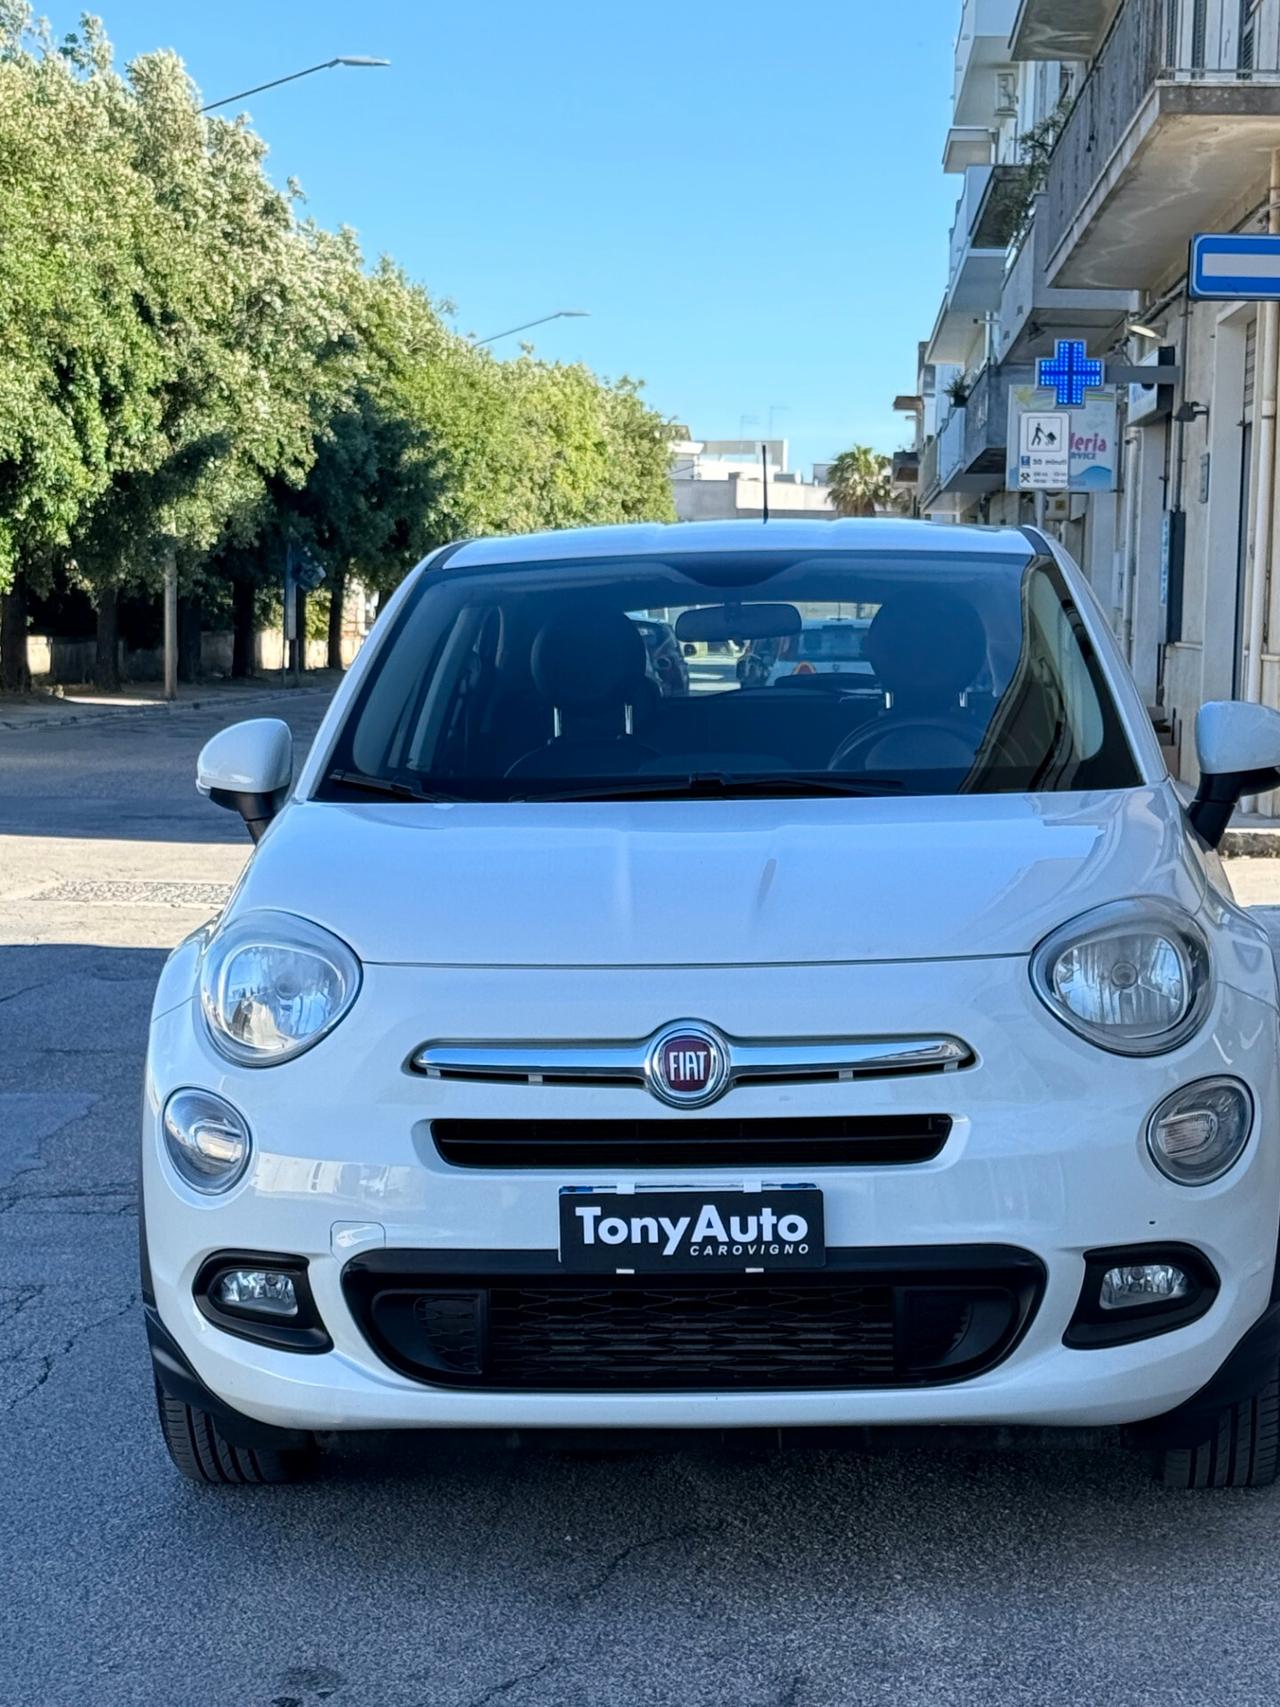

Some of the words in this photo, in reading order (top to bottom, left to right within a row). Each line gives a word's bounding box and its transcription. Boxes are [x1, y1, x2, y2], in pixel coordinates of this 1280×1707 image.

[669, 1051, 707, 1081] FIAT
[575, 1204, 809, 1256] TonyAuto
[689, 1243, 809, 1257] CAROVIGNO
